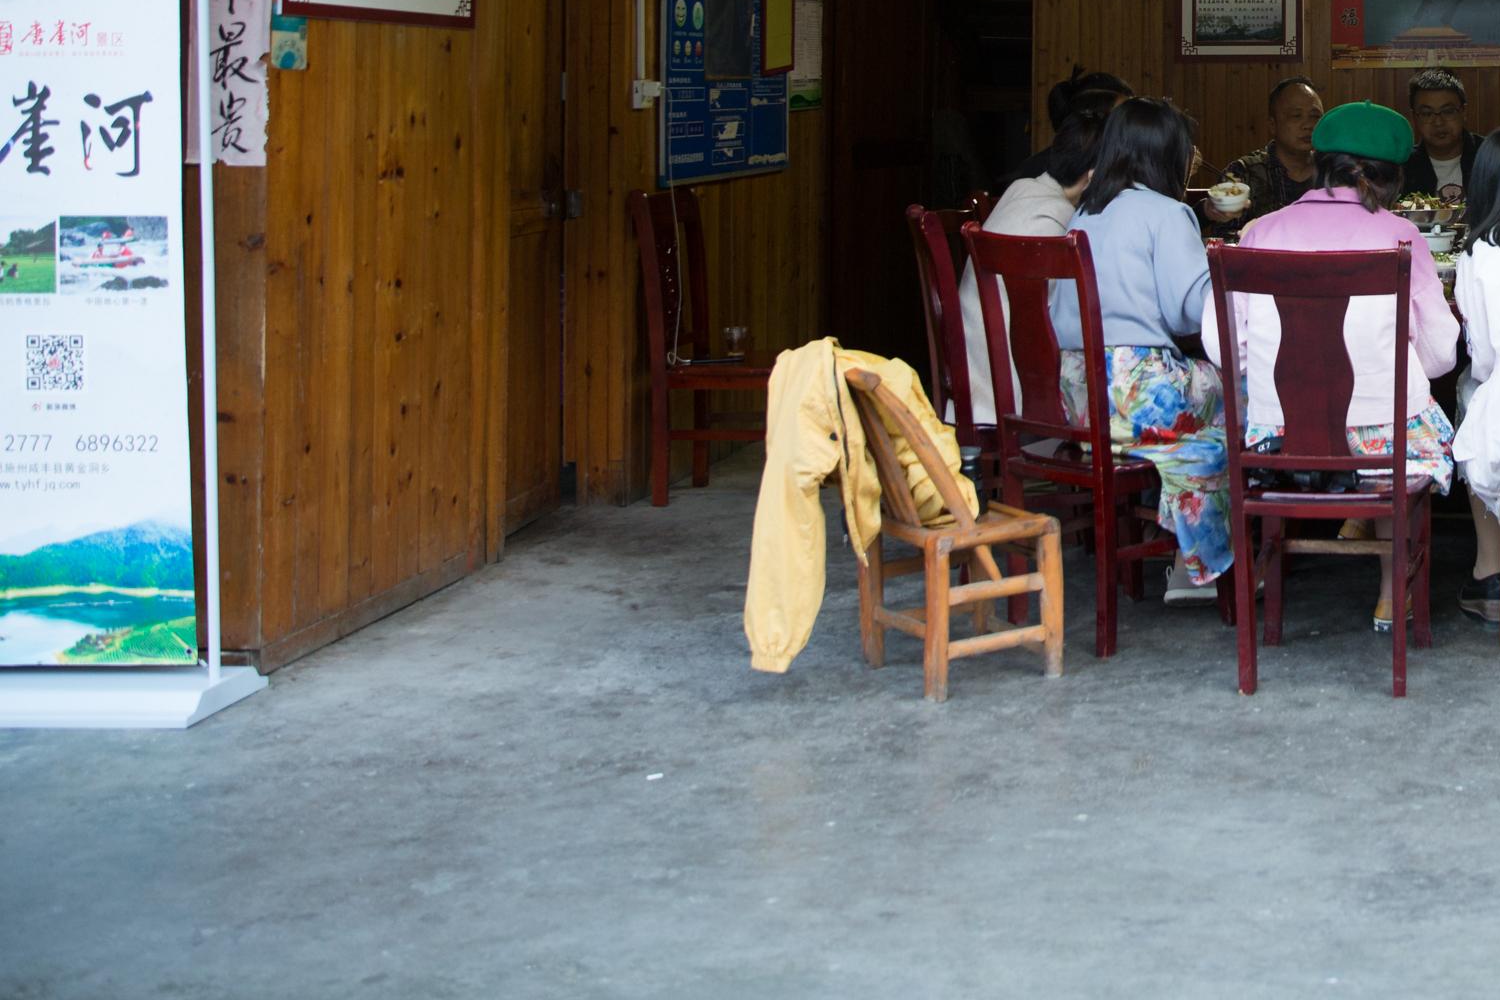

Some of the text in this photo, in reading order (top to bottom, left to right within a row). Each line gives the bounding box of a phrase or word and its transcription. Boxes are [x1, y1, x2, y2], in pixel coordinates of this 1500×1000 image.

[5, 434, 158, 452] 2777 6896322
[0, 462, 110, 473] 施州咸丰县黄金洞乡
